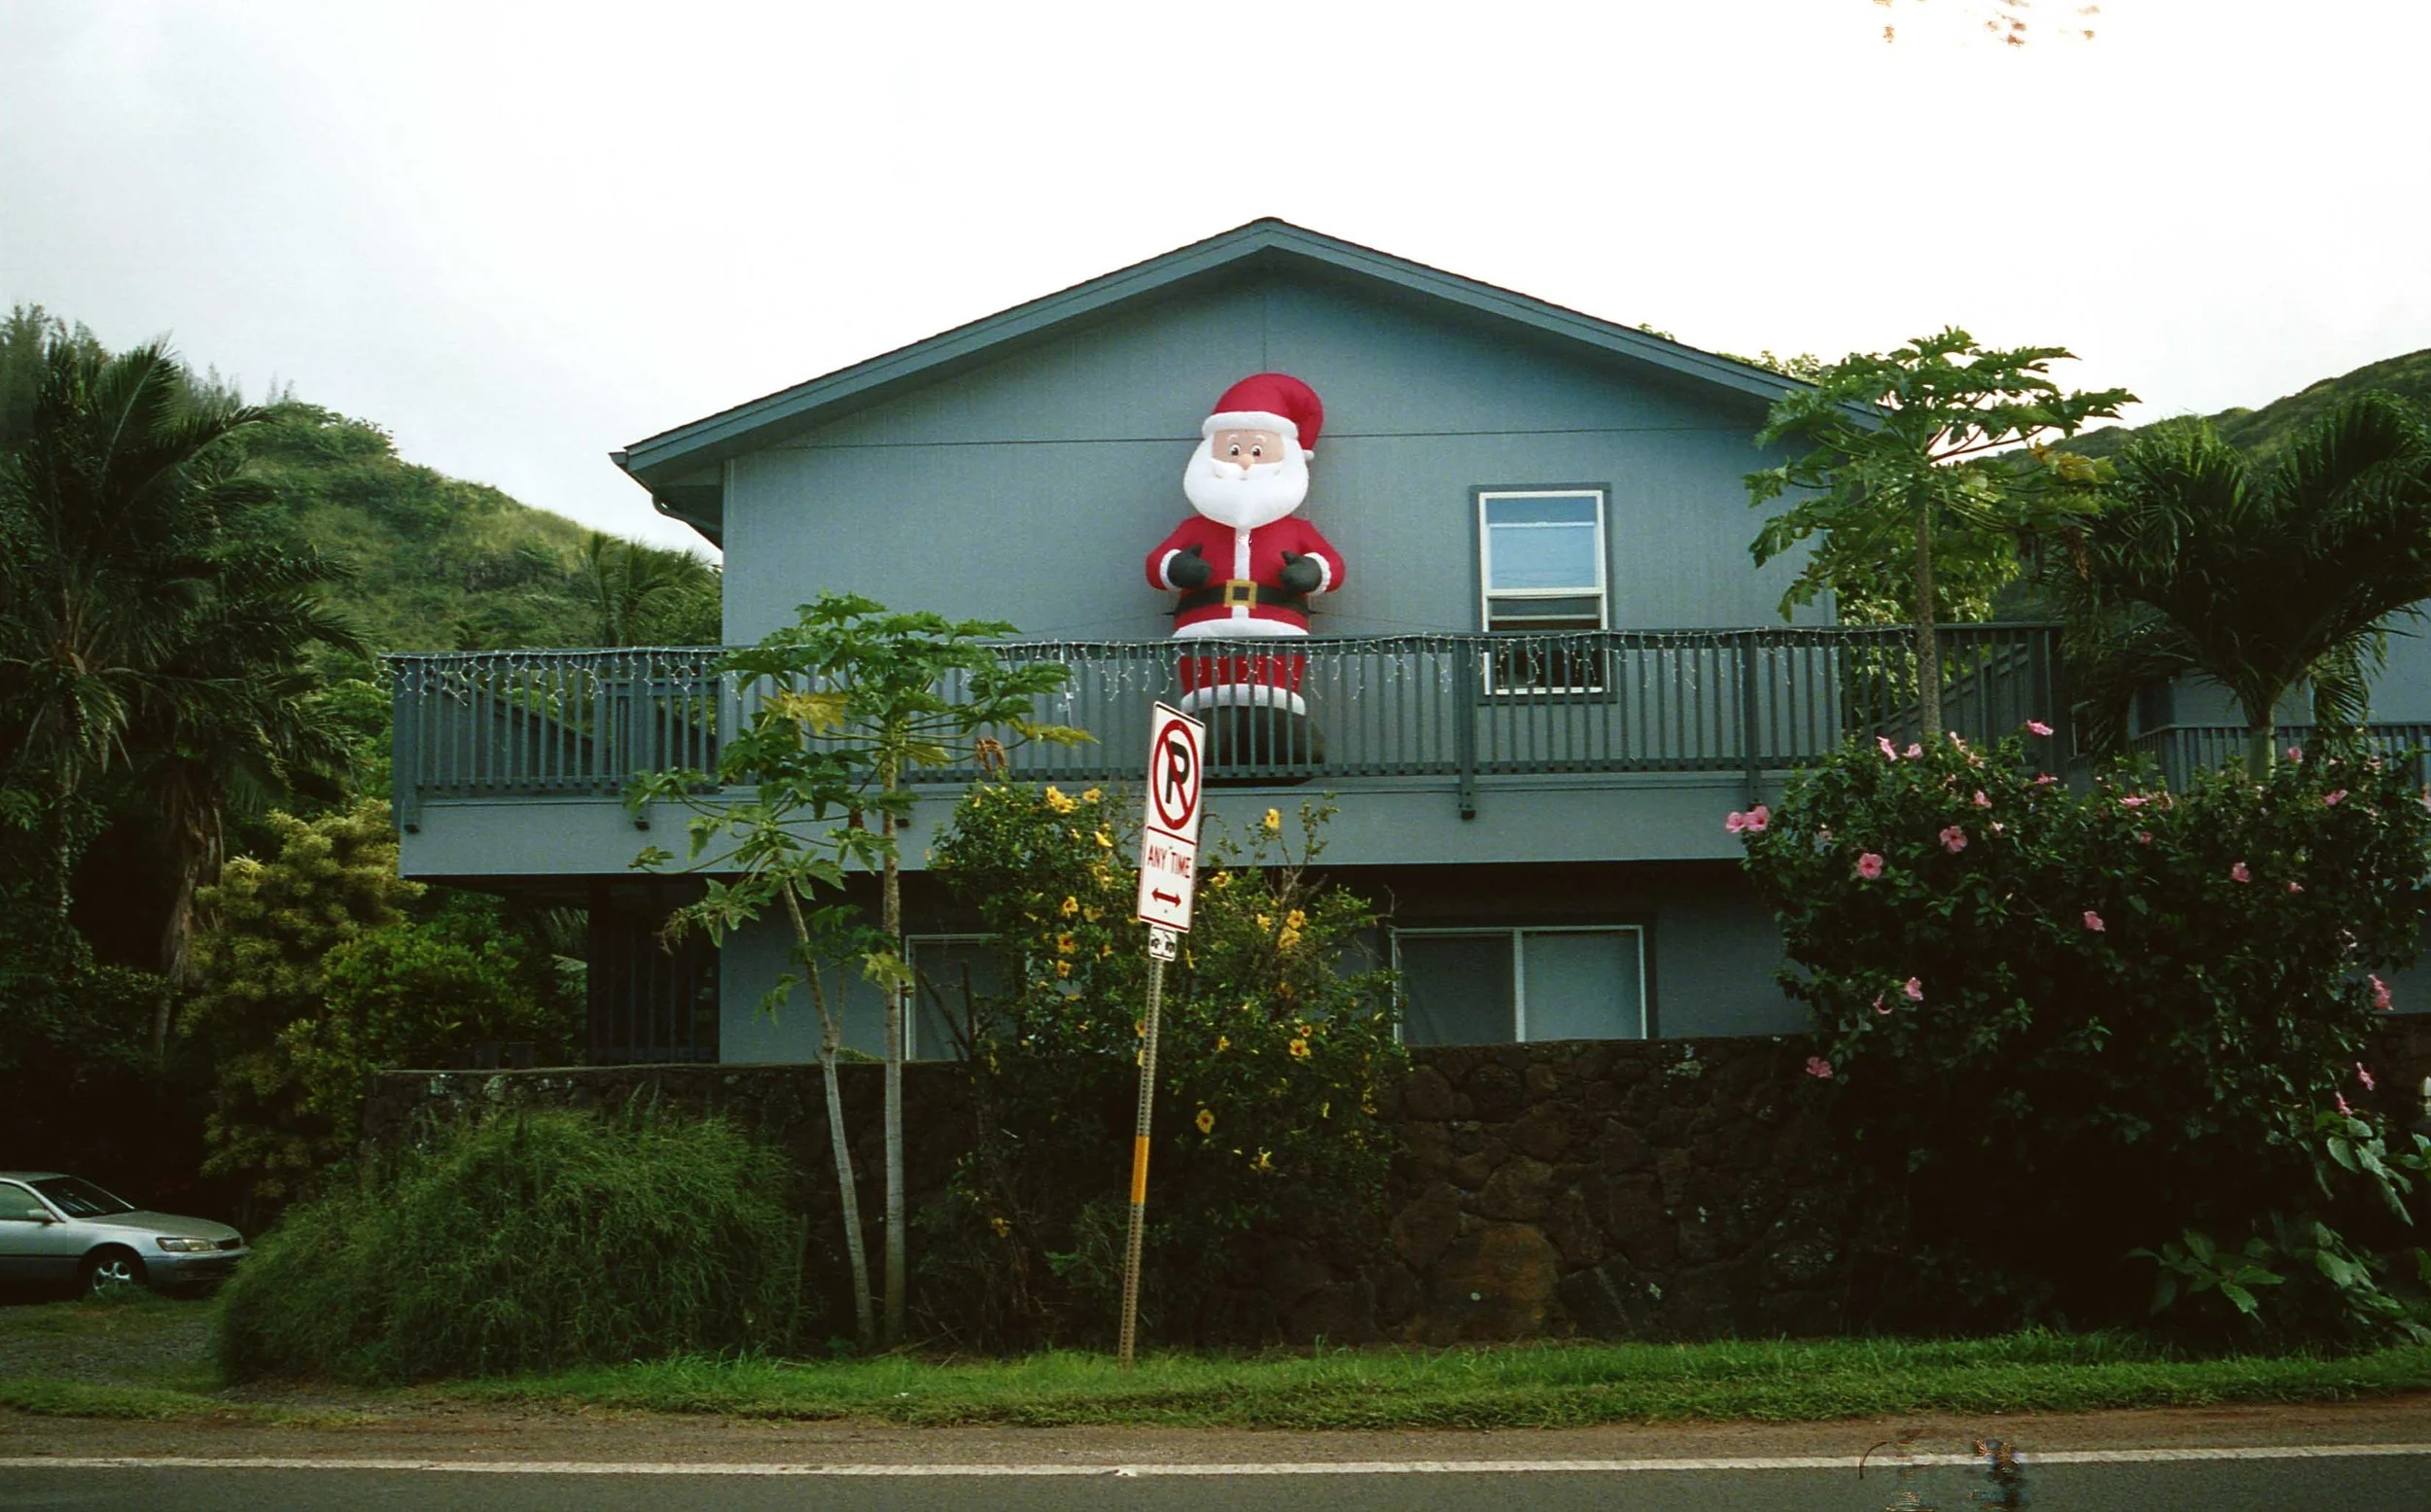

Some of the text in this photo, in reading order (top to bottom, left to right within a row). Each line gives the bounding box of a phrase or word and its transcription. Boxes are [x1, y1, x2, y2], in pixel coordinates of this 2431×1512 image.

[1166, 740, 1190, 804] P
[1147, 844, 1191, 879] ANY TIME
